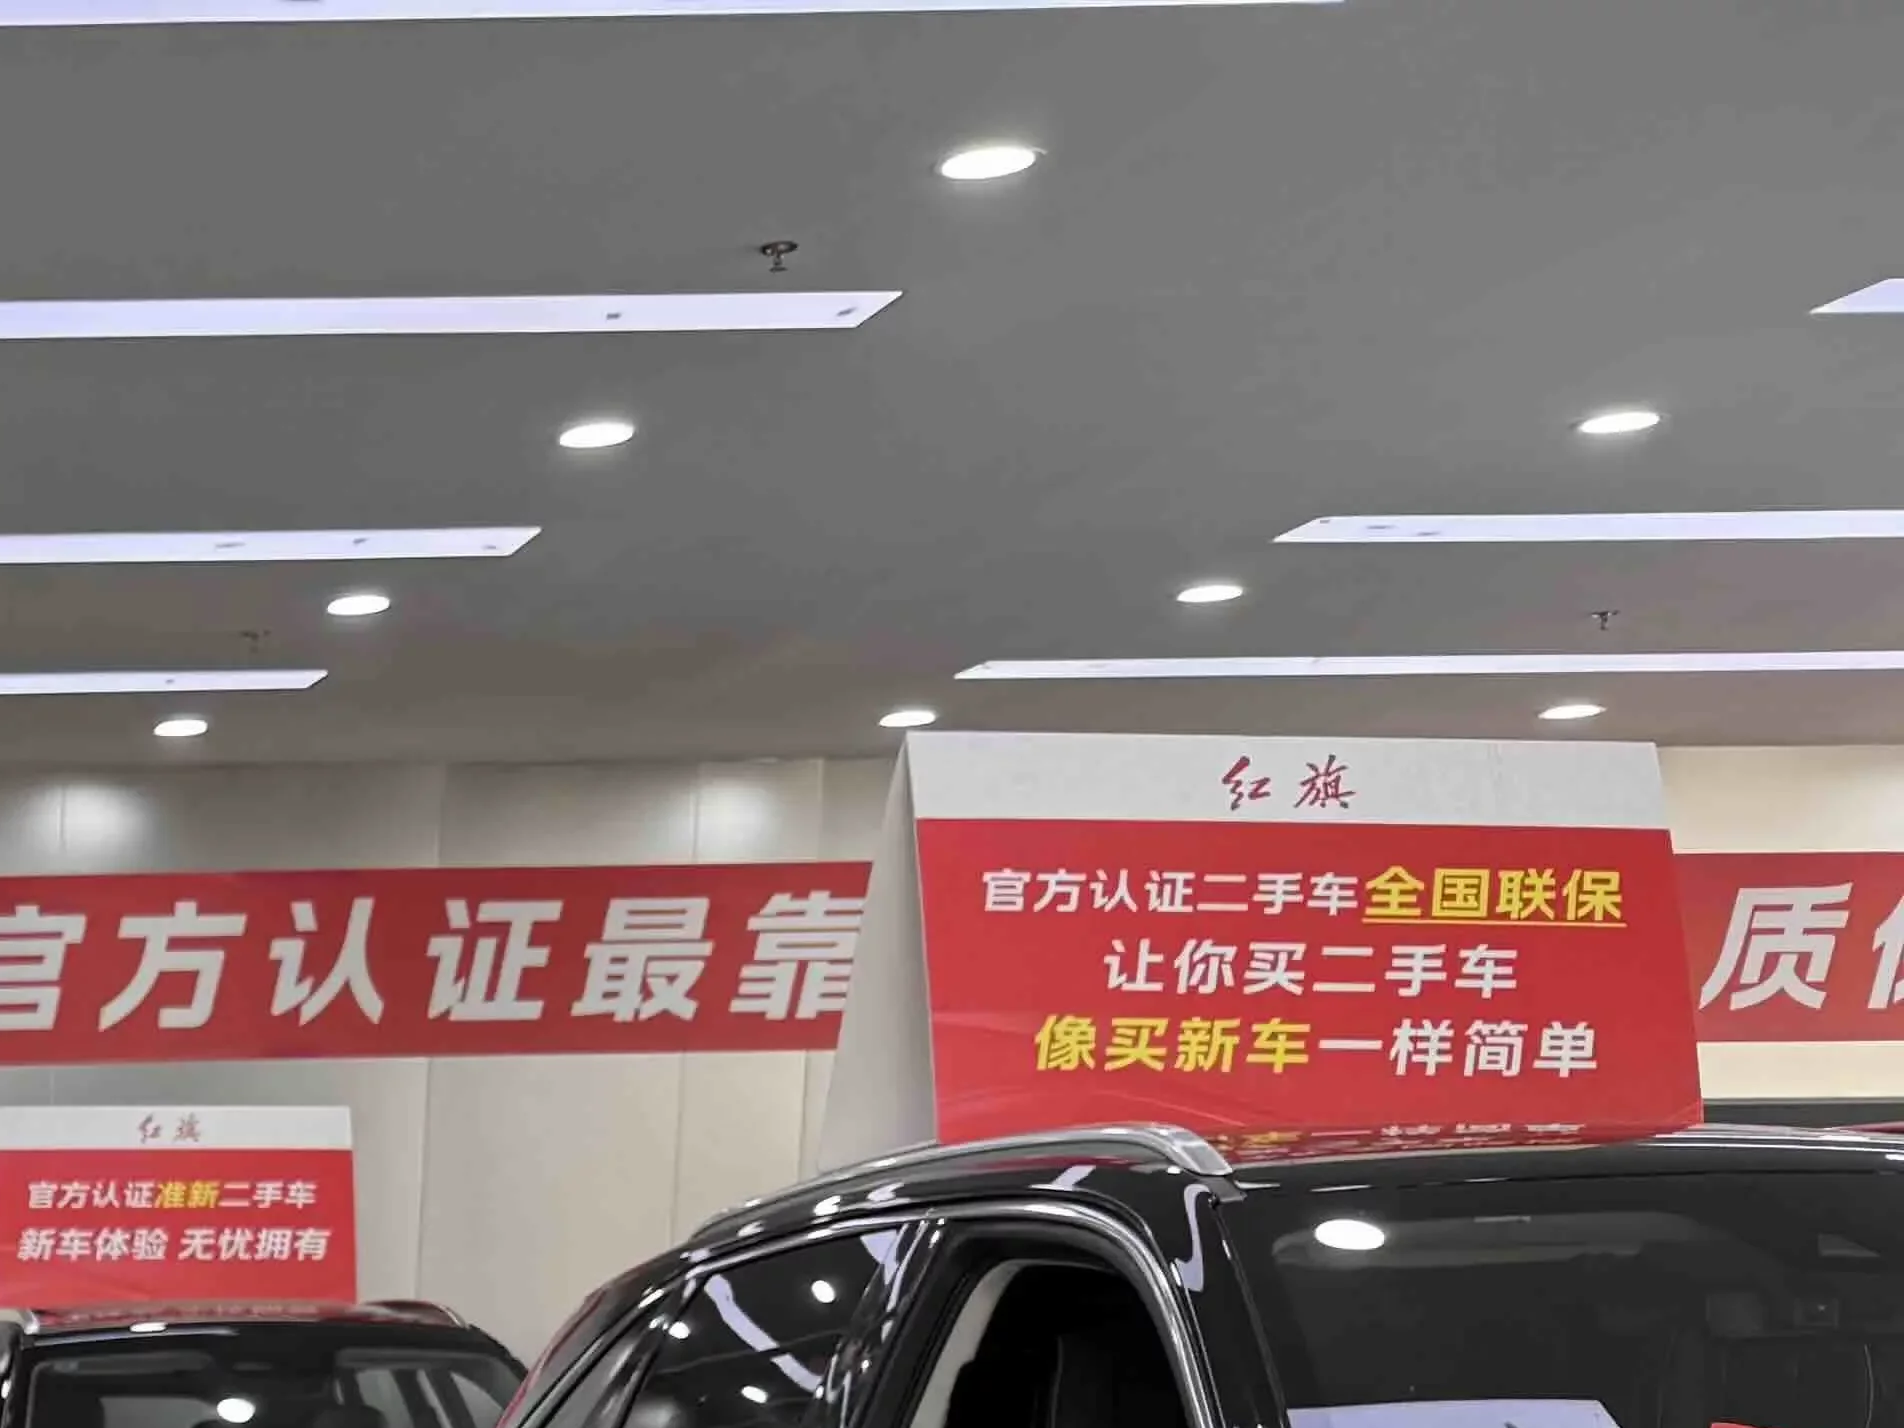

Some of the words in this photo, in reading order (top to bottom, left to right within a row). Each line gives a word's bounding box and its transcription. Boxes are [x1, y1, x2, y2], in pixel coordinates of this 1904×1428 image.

[1222, 755, 1356, 810] 红旗
[981, 866, 1625, 923] 官方认证二手车全国联保
[1103, 938, 1518, 999] 让你买二手车
[1034, 1014, 1598, 1076] 像买新车一样简单
[138, 1114, 202, 1145] 红旗
[27, 1178, 317, 1211] 官方认证准新二手车
[17, 1228, 168, 1262] 新车体验
[179, 1228, 330, 1262] 无忧拥有
